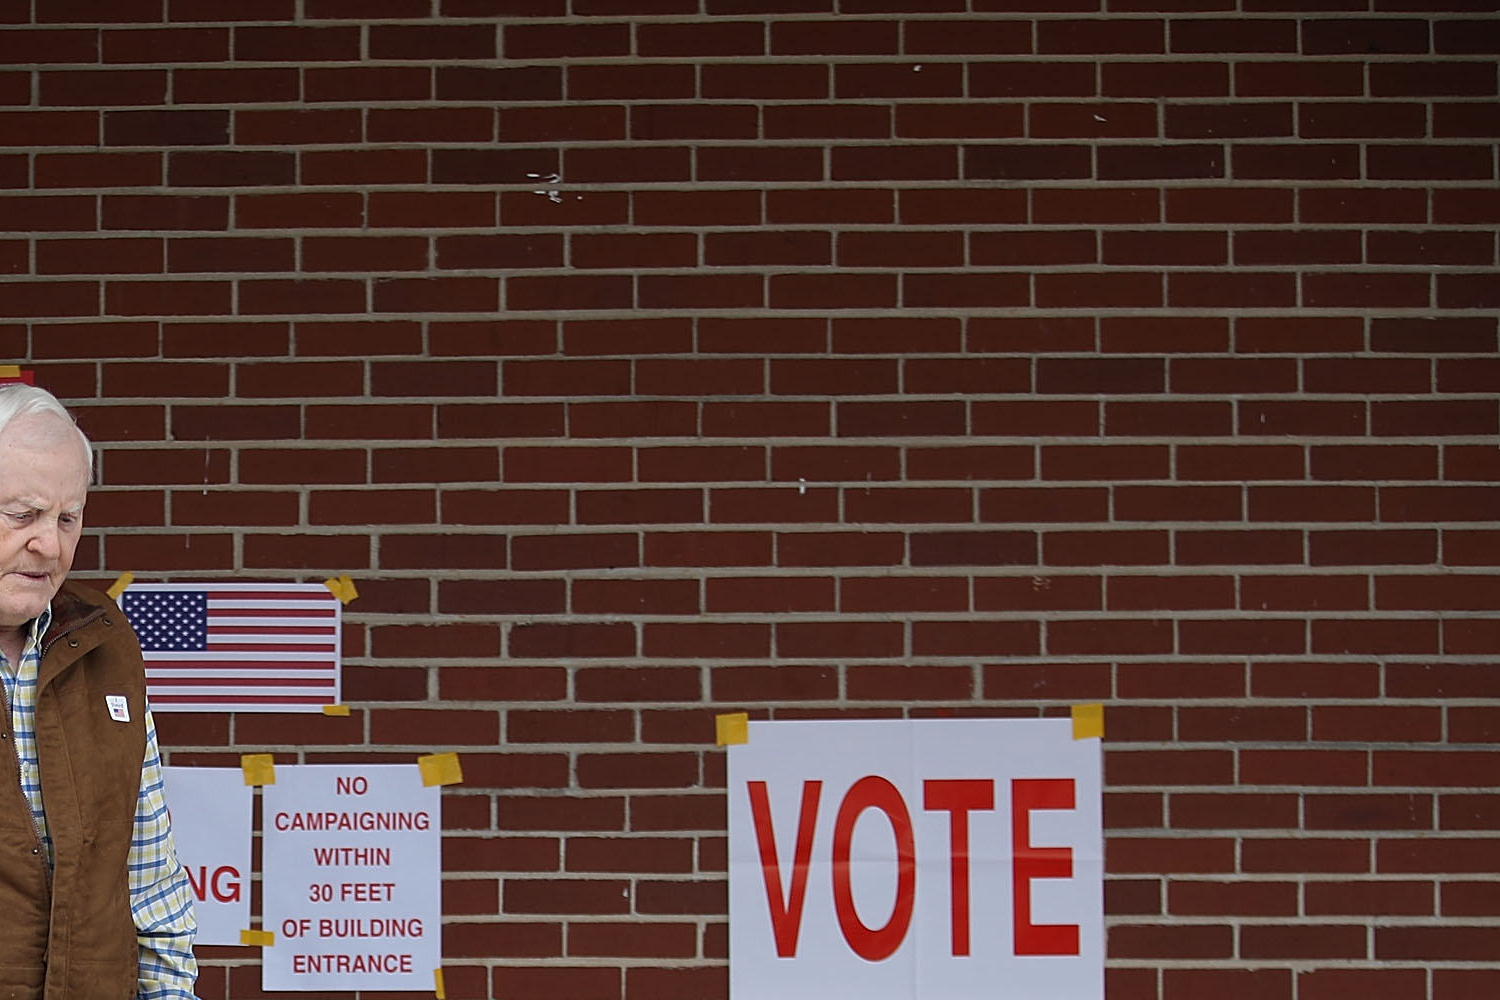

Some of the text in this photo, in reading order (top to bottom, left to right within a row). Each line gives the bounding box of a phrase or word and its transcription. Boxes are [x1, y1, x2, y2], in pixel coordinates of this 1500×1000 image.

[336, 776, 368, 795] NO
[275, 811, 430, 831] CAMPAIGNING
[314, 848, 391, 866] WITHIN
[746, 774, 1081, 962] VOTE
[184, 865, 241, 903] NG
[309, 883, 396, 902] 30 FEET
[282, 918, 424, 938] OF BUILDING
[293, 954, 413, 974] ENTRANCE
